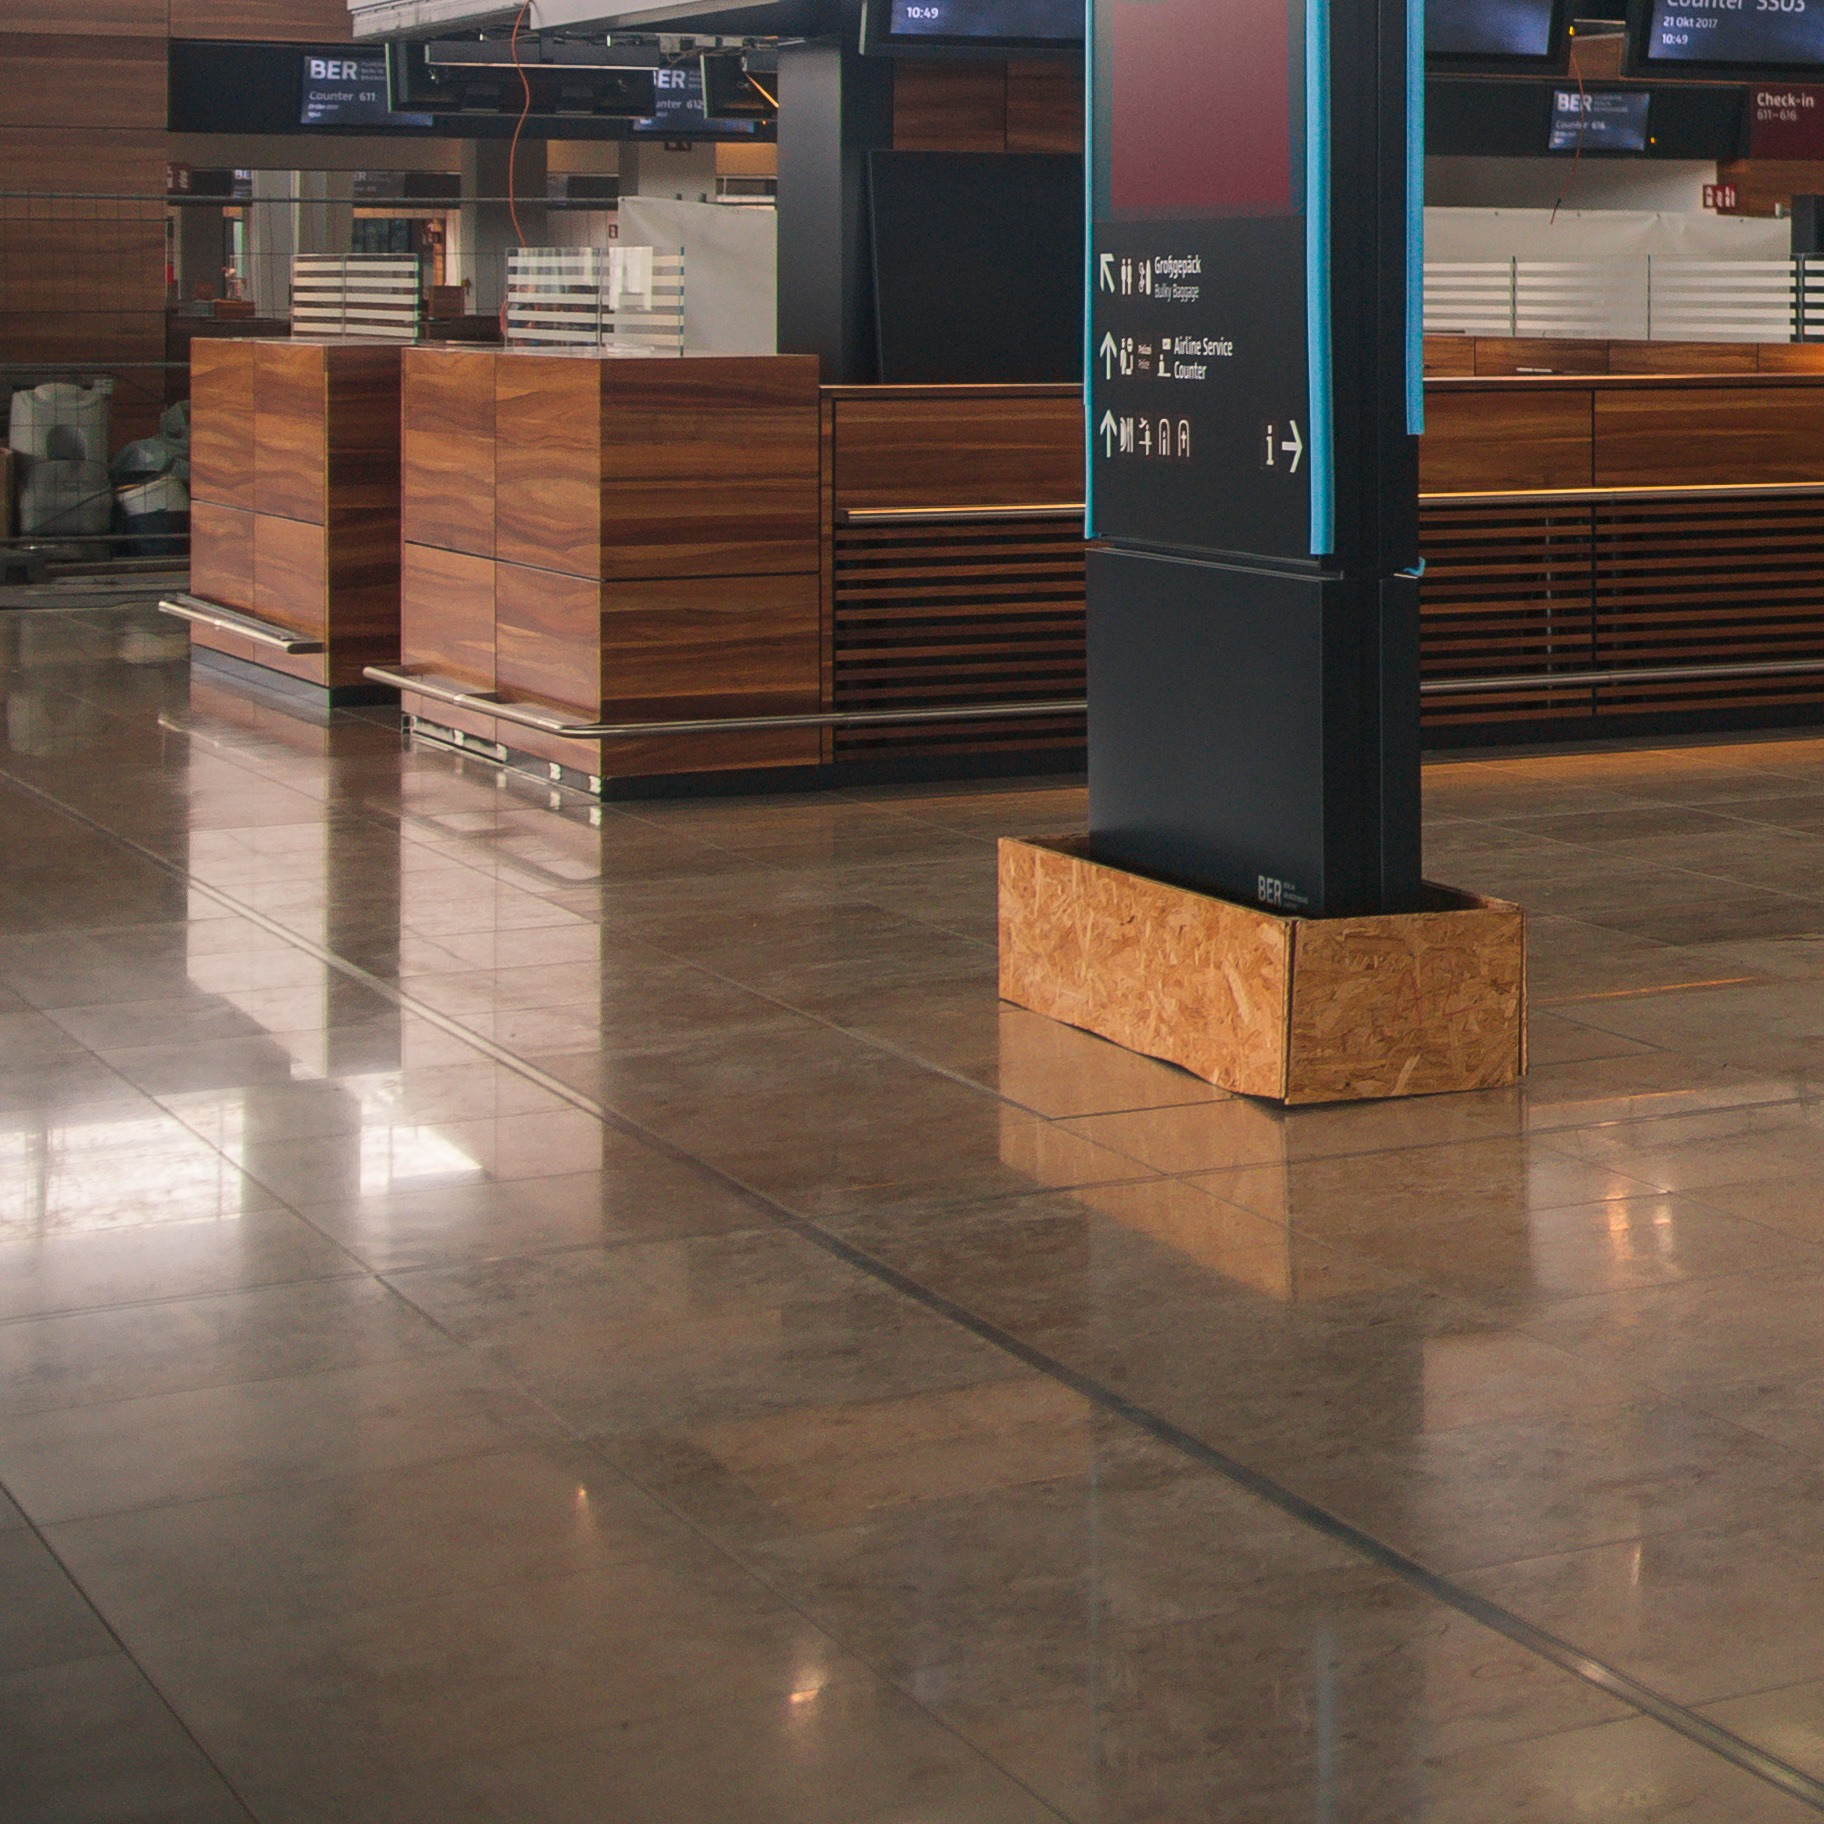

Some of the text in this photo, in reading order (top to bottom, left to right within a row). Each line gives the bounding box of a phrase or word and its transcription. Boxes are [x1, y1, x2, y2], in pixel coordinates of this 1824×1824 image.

[907, 7, 939, 19] 10:49
[1663, 16, 1717, 29] 21 Okt 2017
[1662, 34, 1688, 44] 10:49
[310, 59, 358, 80] BER
[653, 69, 686, 89] ER
[309, 91, 354, 101] Counter
[1557, 93, 1592, 112] BER
[1757, 92, 1815, 108] Check-in
[1154, 254, 1202, 279] Großgepäck
[1174, 336, 1233, 356] Airline Service
[1174, 361, 1207, 379] Counter
[1258, 875, 1282, 907] BER
